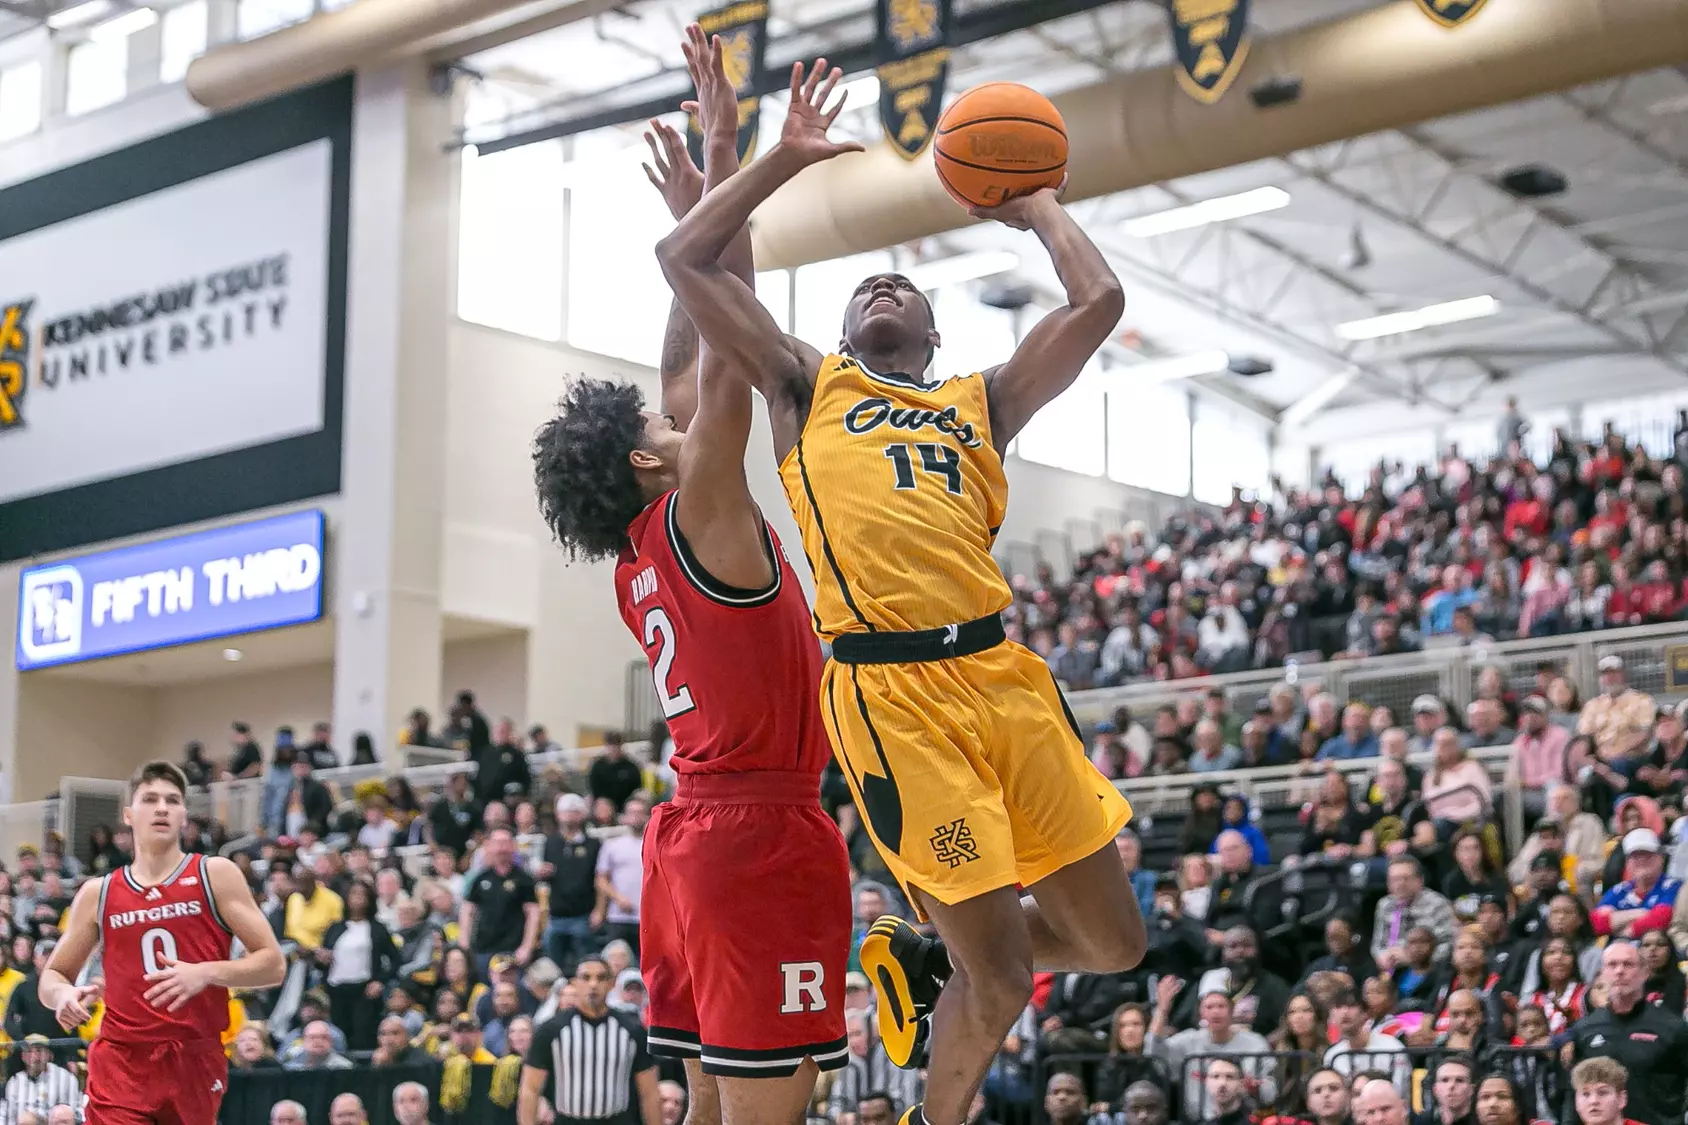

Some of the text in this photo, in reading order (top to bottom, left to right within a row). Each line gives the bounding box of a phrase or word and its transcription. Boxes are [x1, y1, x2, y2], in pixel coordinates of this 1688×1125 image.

[43, 253, 289, 346] KENNESAW STATE
[41, 297, 288, 388] UNIVERSITY
[844, 398, 982, 449] Owls
[883, 442, 964, 496] 14
[91, 566, 194, 627] FIFTH
[203, 543, 320, 606] THIRD
[643, 605, 697, 720] 2
[109, 900, 202, 929] RUTGERS
[140, 927, 178, 976] 0
[780, 961, 827, 1014] R
